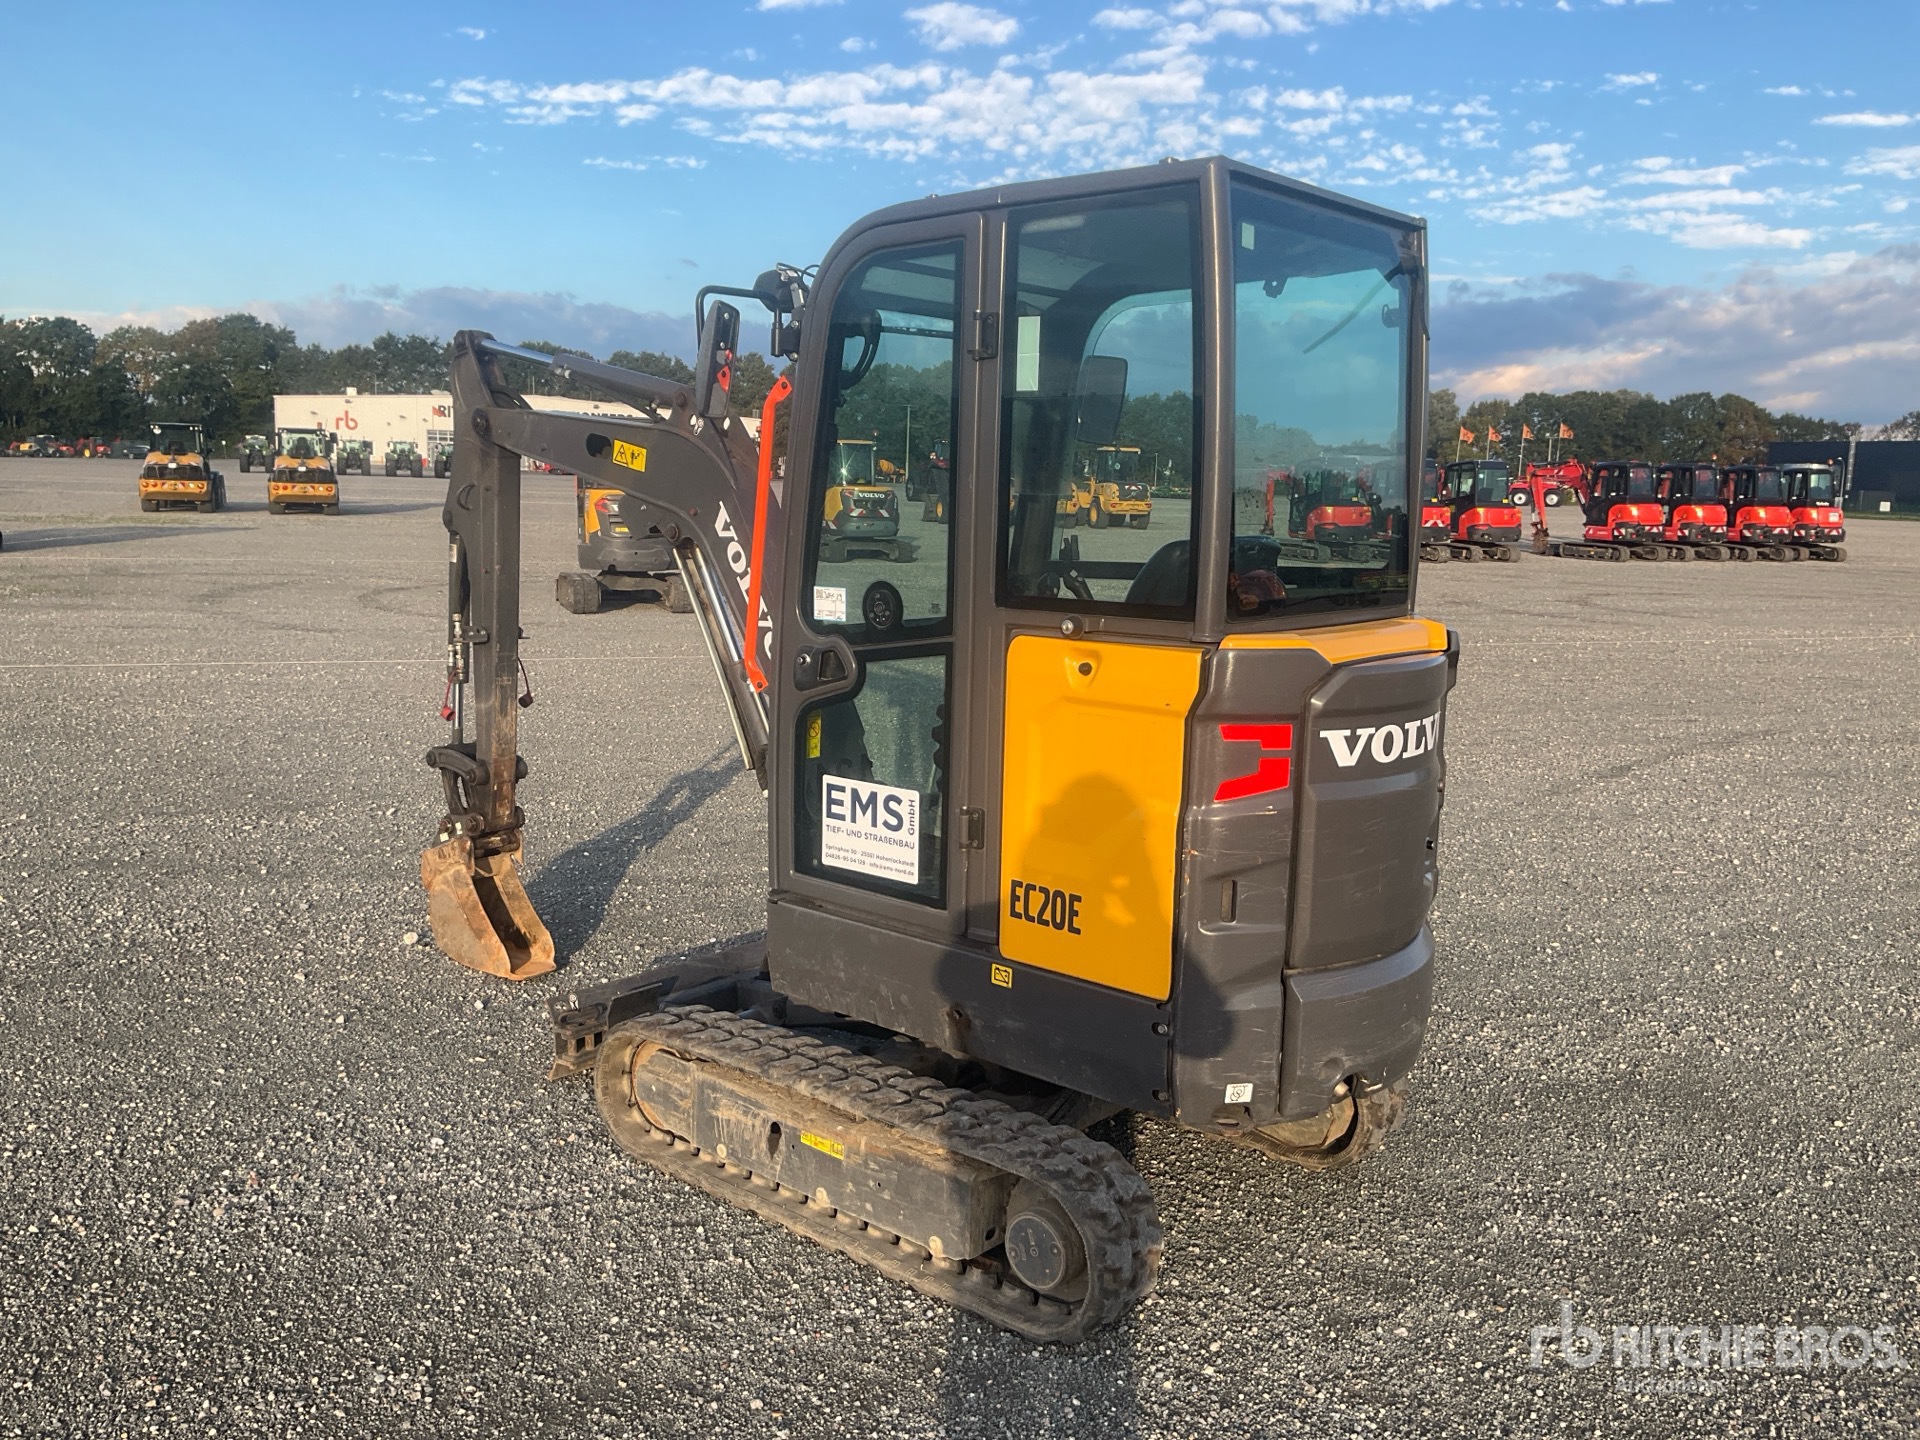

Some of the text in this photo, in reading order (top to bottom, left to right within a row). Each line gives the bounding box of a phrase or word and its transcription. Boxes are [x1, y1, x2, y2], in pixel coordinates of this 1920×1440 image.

[335, 410, 358, 430] rb
[1319, 710, 1442, 768] VOLV
[826, 782, 904, 833] EMS
[907, 799, 916, 836] GmbH
[825, 824, 916, 850] TIEF- UND STRAßENBAU
[1009, 878, 1083, 936] EC20E
